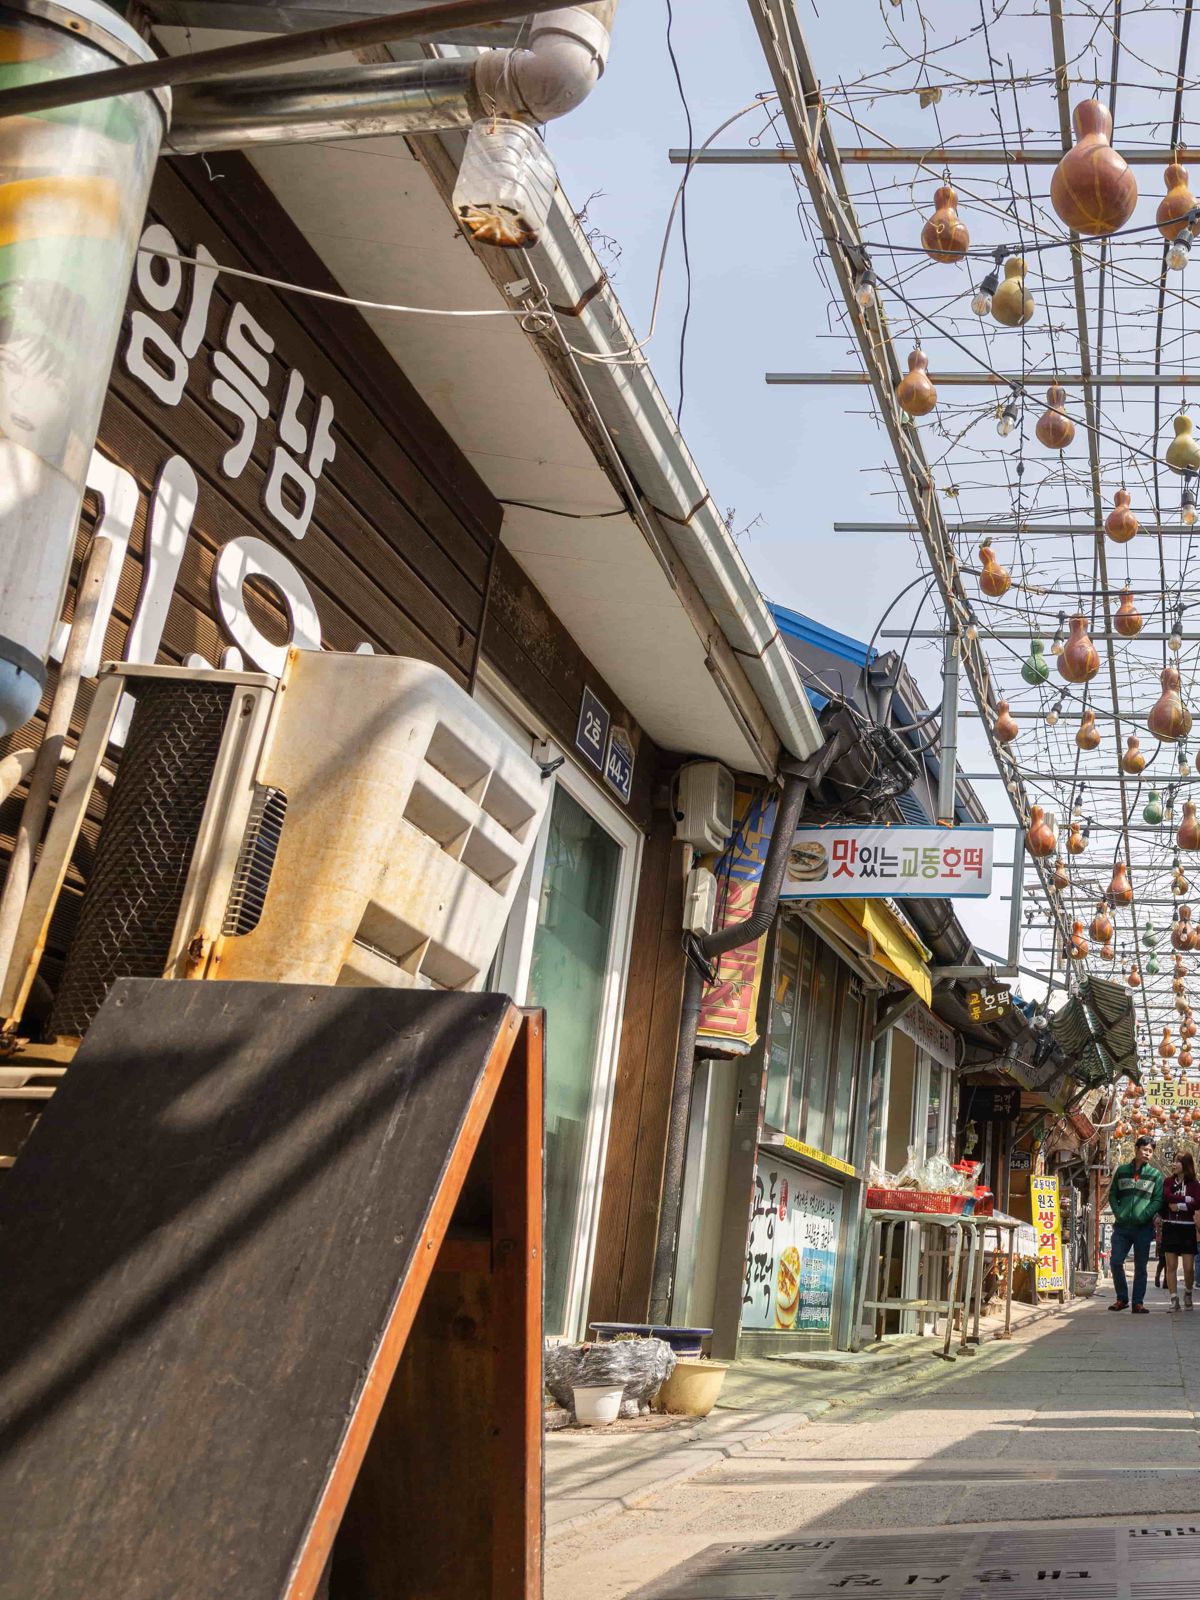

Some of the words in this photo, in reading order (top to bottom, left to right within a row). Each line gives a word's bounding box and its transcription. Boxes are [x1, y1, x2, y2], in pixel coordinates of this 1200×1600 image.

[584, 711, 602, 750] 2호
[609, 753, 630, 793] 44-2
[984, 990, 1010, 1011] 호떡
[1037, 1194, 1055, 1209] 원조
[1038, 1211, 1058, 1273] 쌍화차
